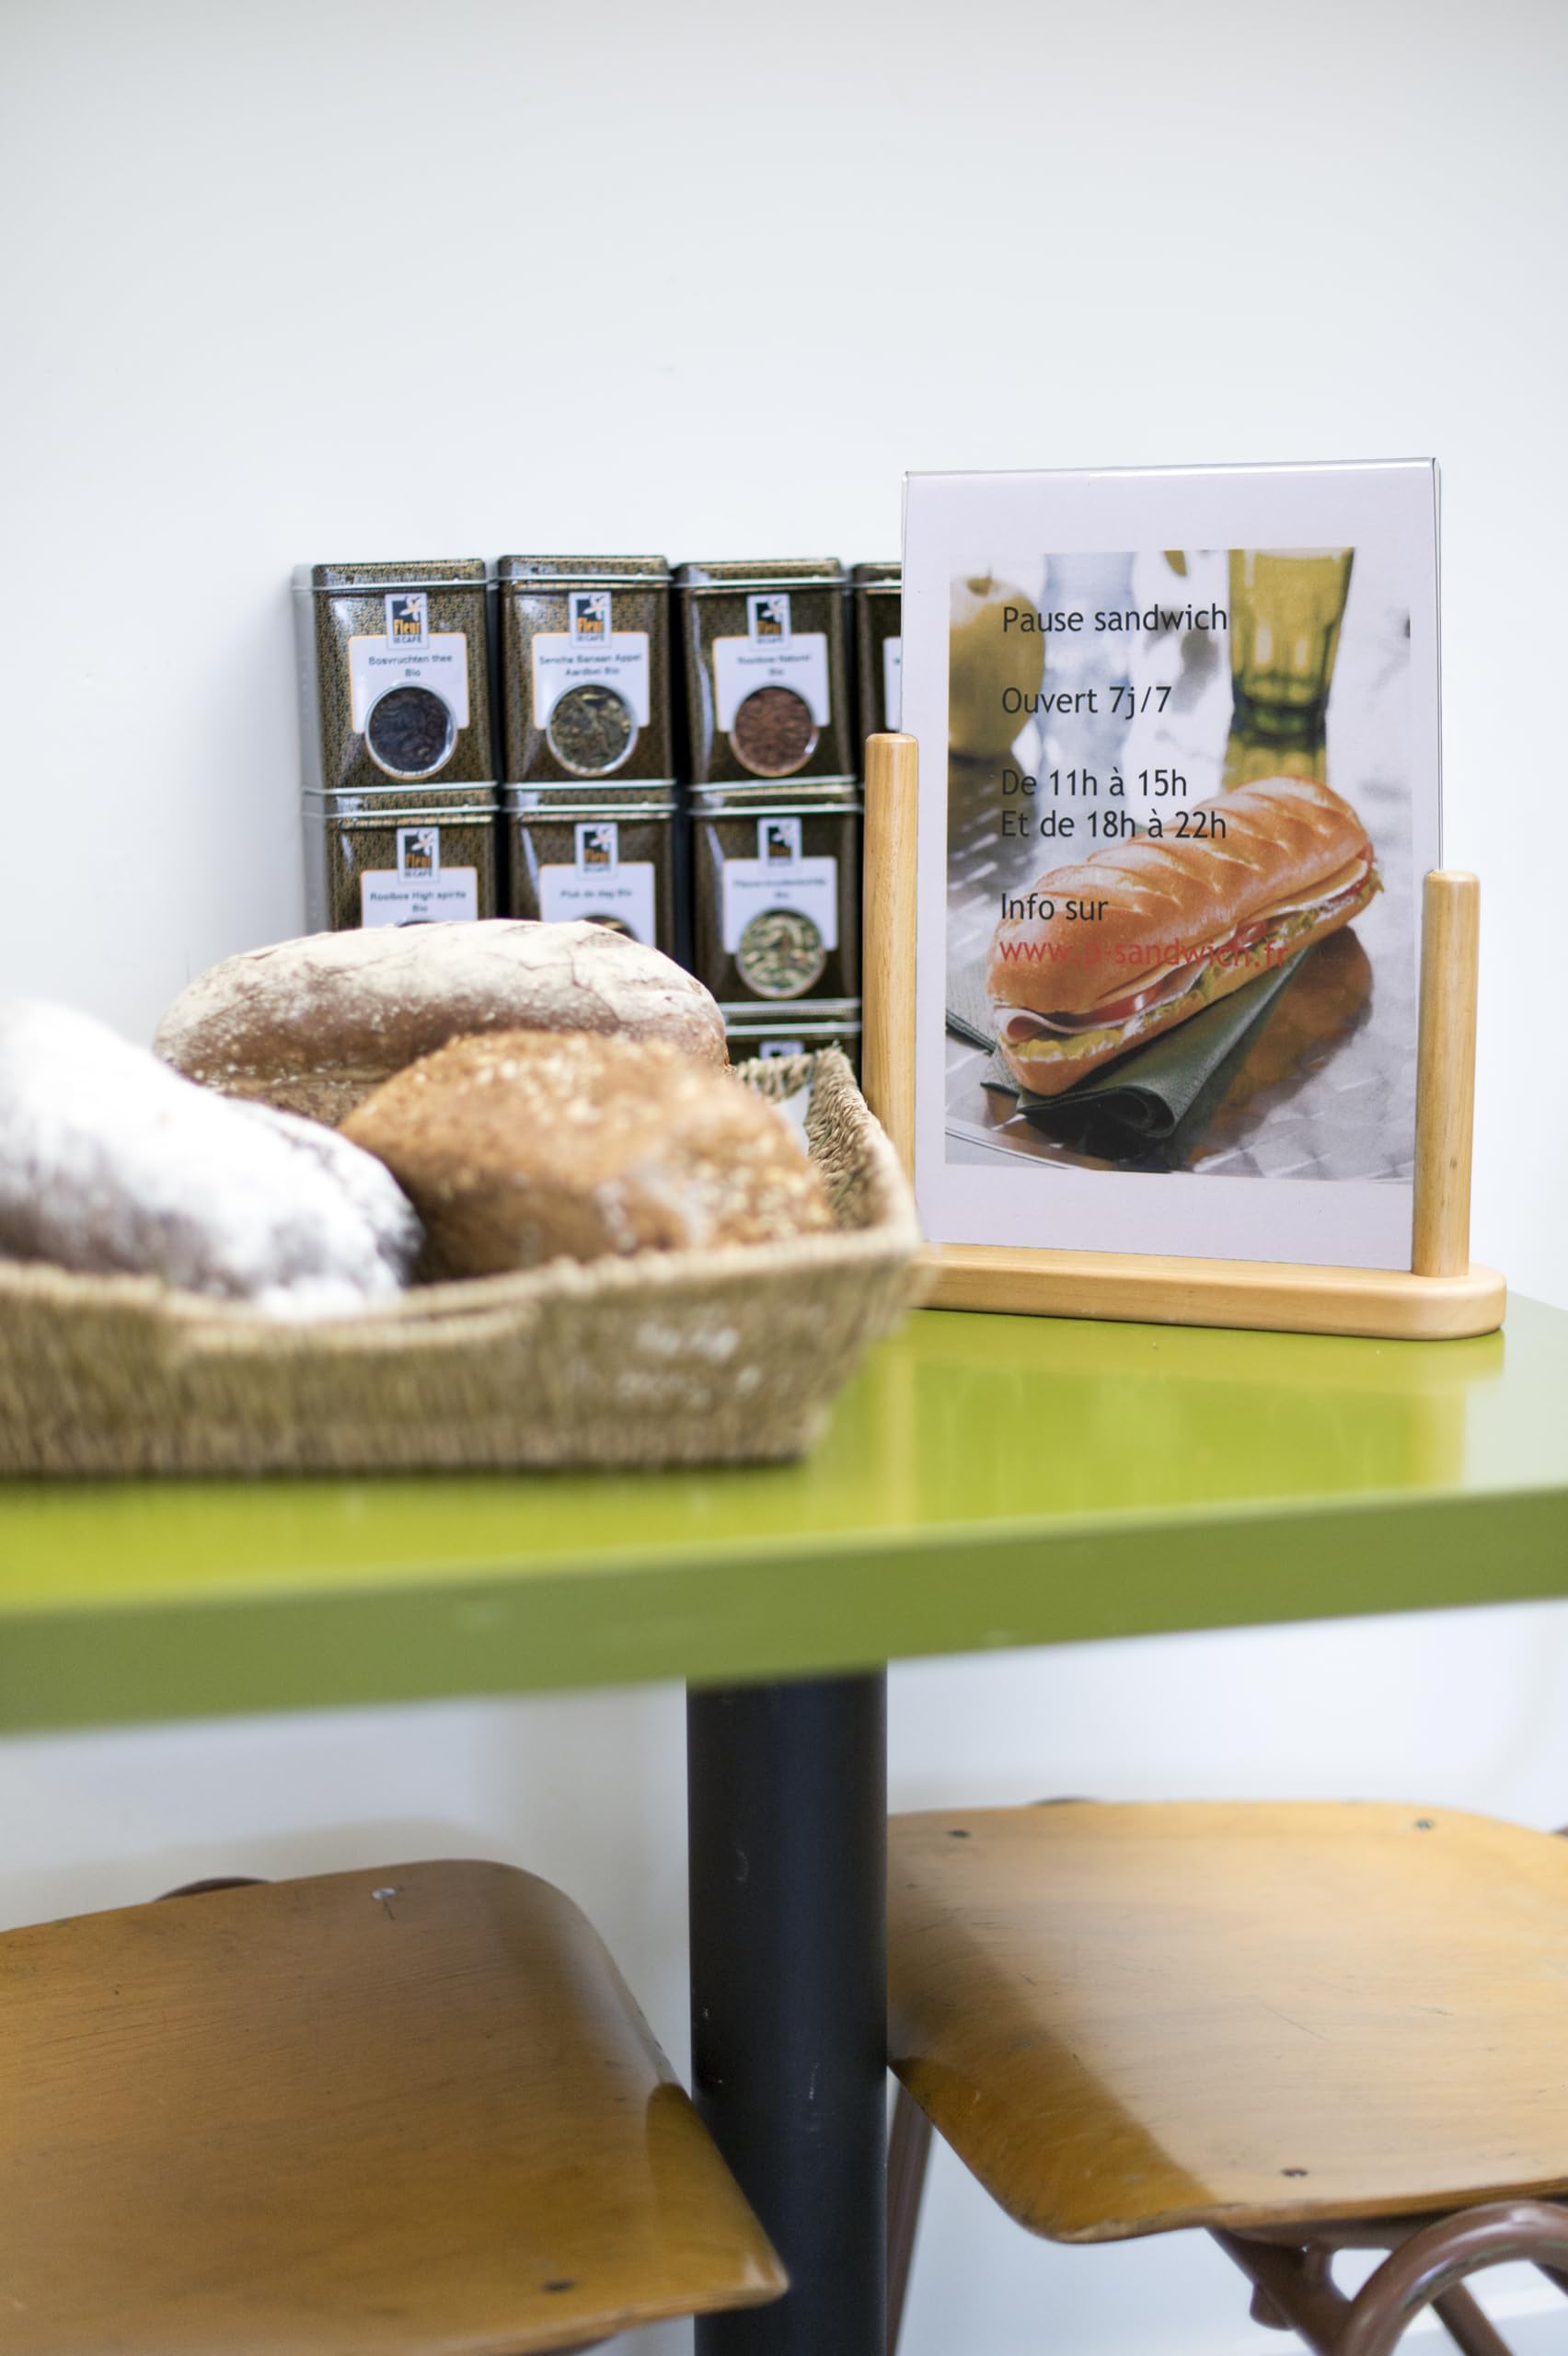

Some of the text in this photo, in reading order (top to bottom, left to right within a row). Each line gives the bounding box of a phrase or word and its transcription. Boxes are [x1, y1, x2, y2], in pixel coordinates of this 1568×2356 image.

[1003, 604, 1228, 632] Pause sandwich
[405, 668, 421, 677] Bio
[432, 654, 453, 664] thee
[1002, 686, 1172, 720] Ouvert 7j/7
[1002, 767, 1188, 797] De 11h à 15h
[1001, 809, 1227, 838] Et de 18h à 22h
[1000, 893, 1109, 920] Info sur
[999, 938, 1289, 971] www.p-sandwich.fr
